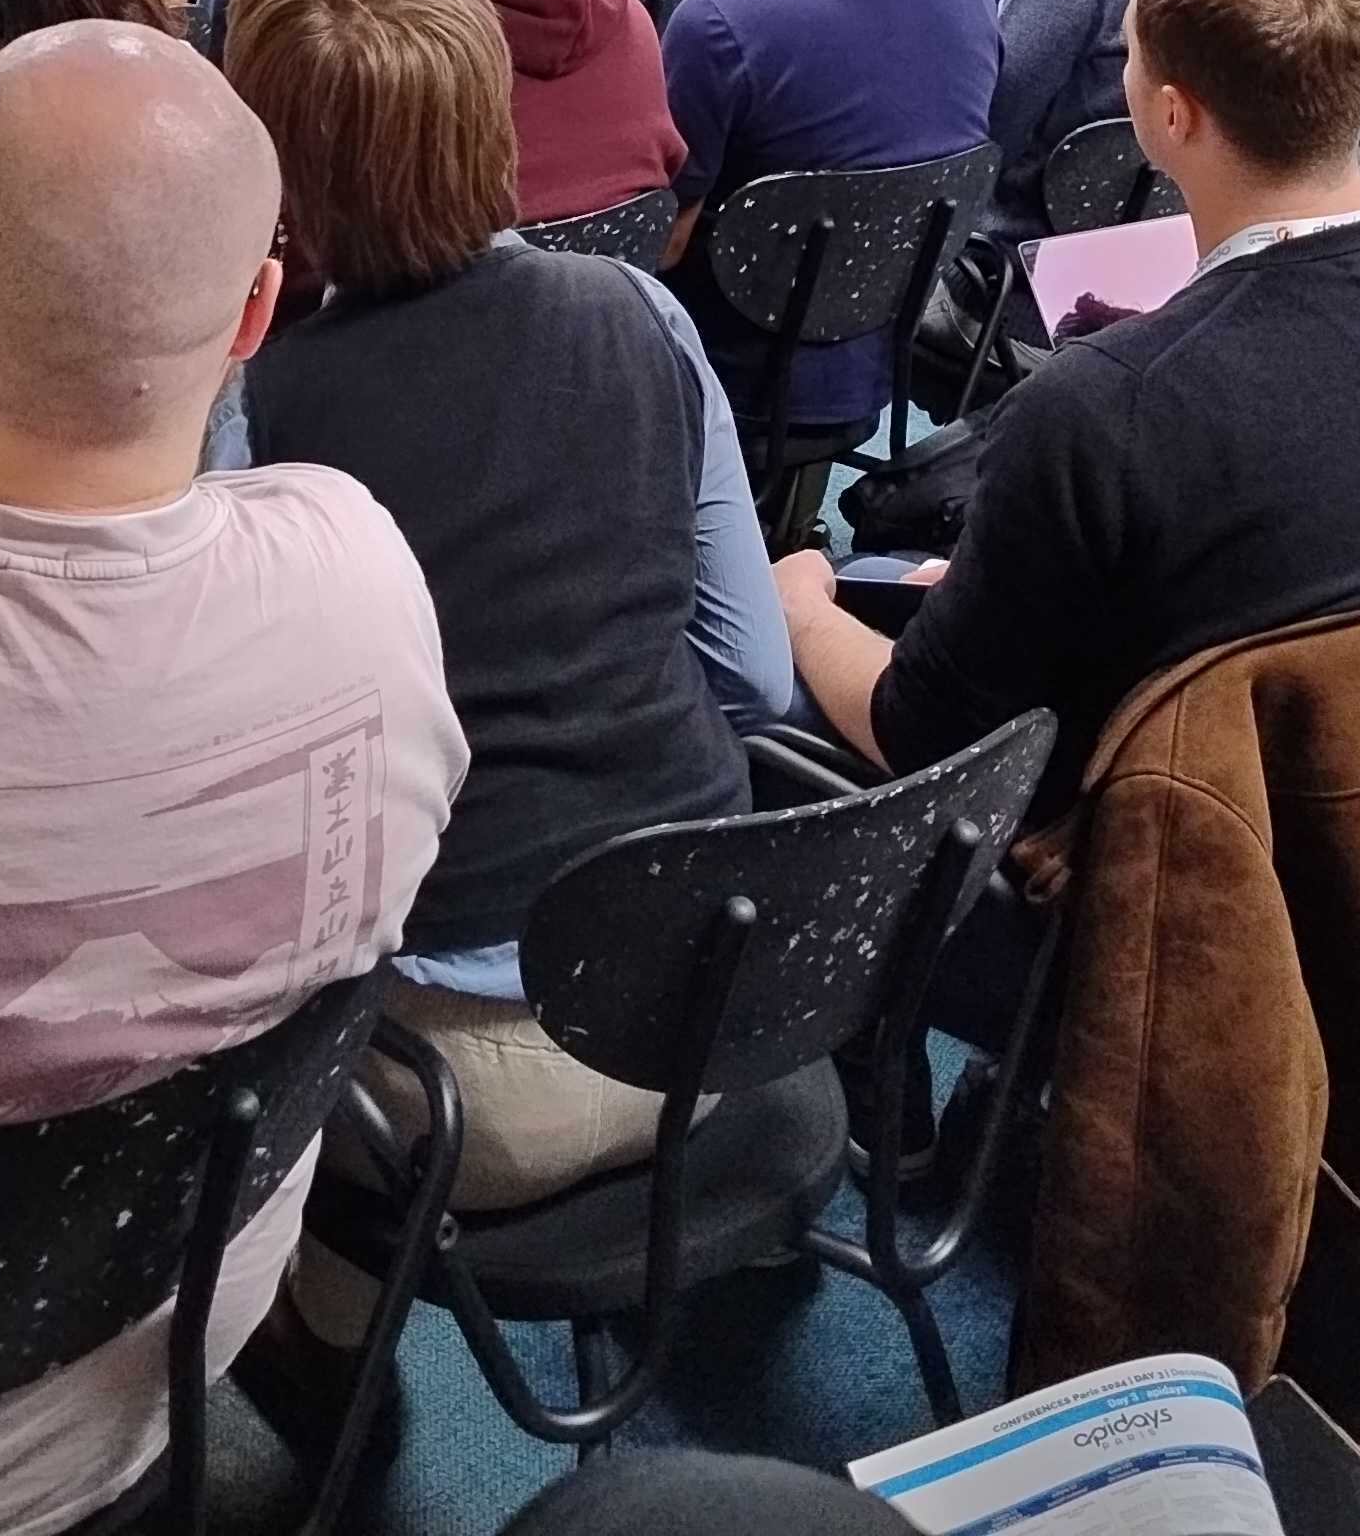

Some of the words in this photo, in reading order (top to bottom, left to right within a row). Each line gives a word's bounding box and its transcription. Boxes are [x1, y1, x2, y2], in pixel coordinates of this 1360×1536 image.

[993, 1396, 1072, 1434] CONFERENCES
[1072, 1387, 1100, 1403] Paris
[1100, 1379, 1128, 1395] 2024
[1134, 1372, 1157, 1385] DAY
[1107, 1395, 1129, 1410] Day
[1074, 1408, 1173, 1448] apidays
